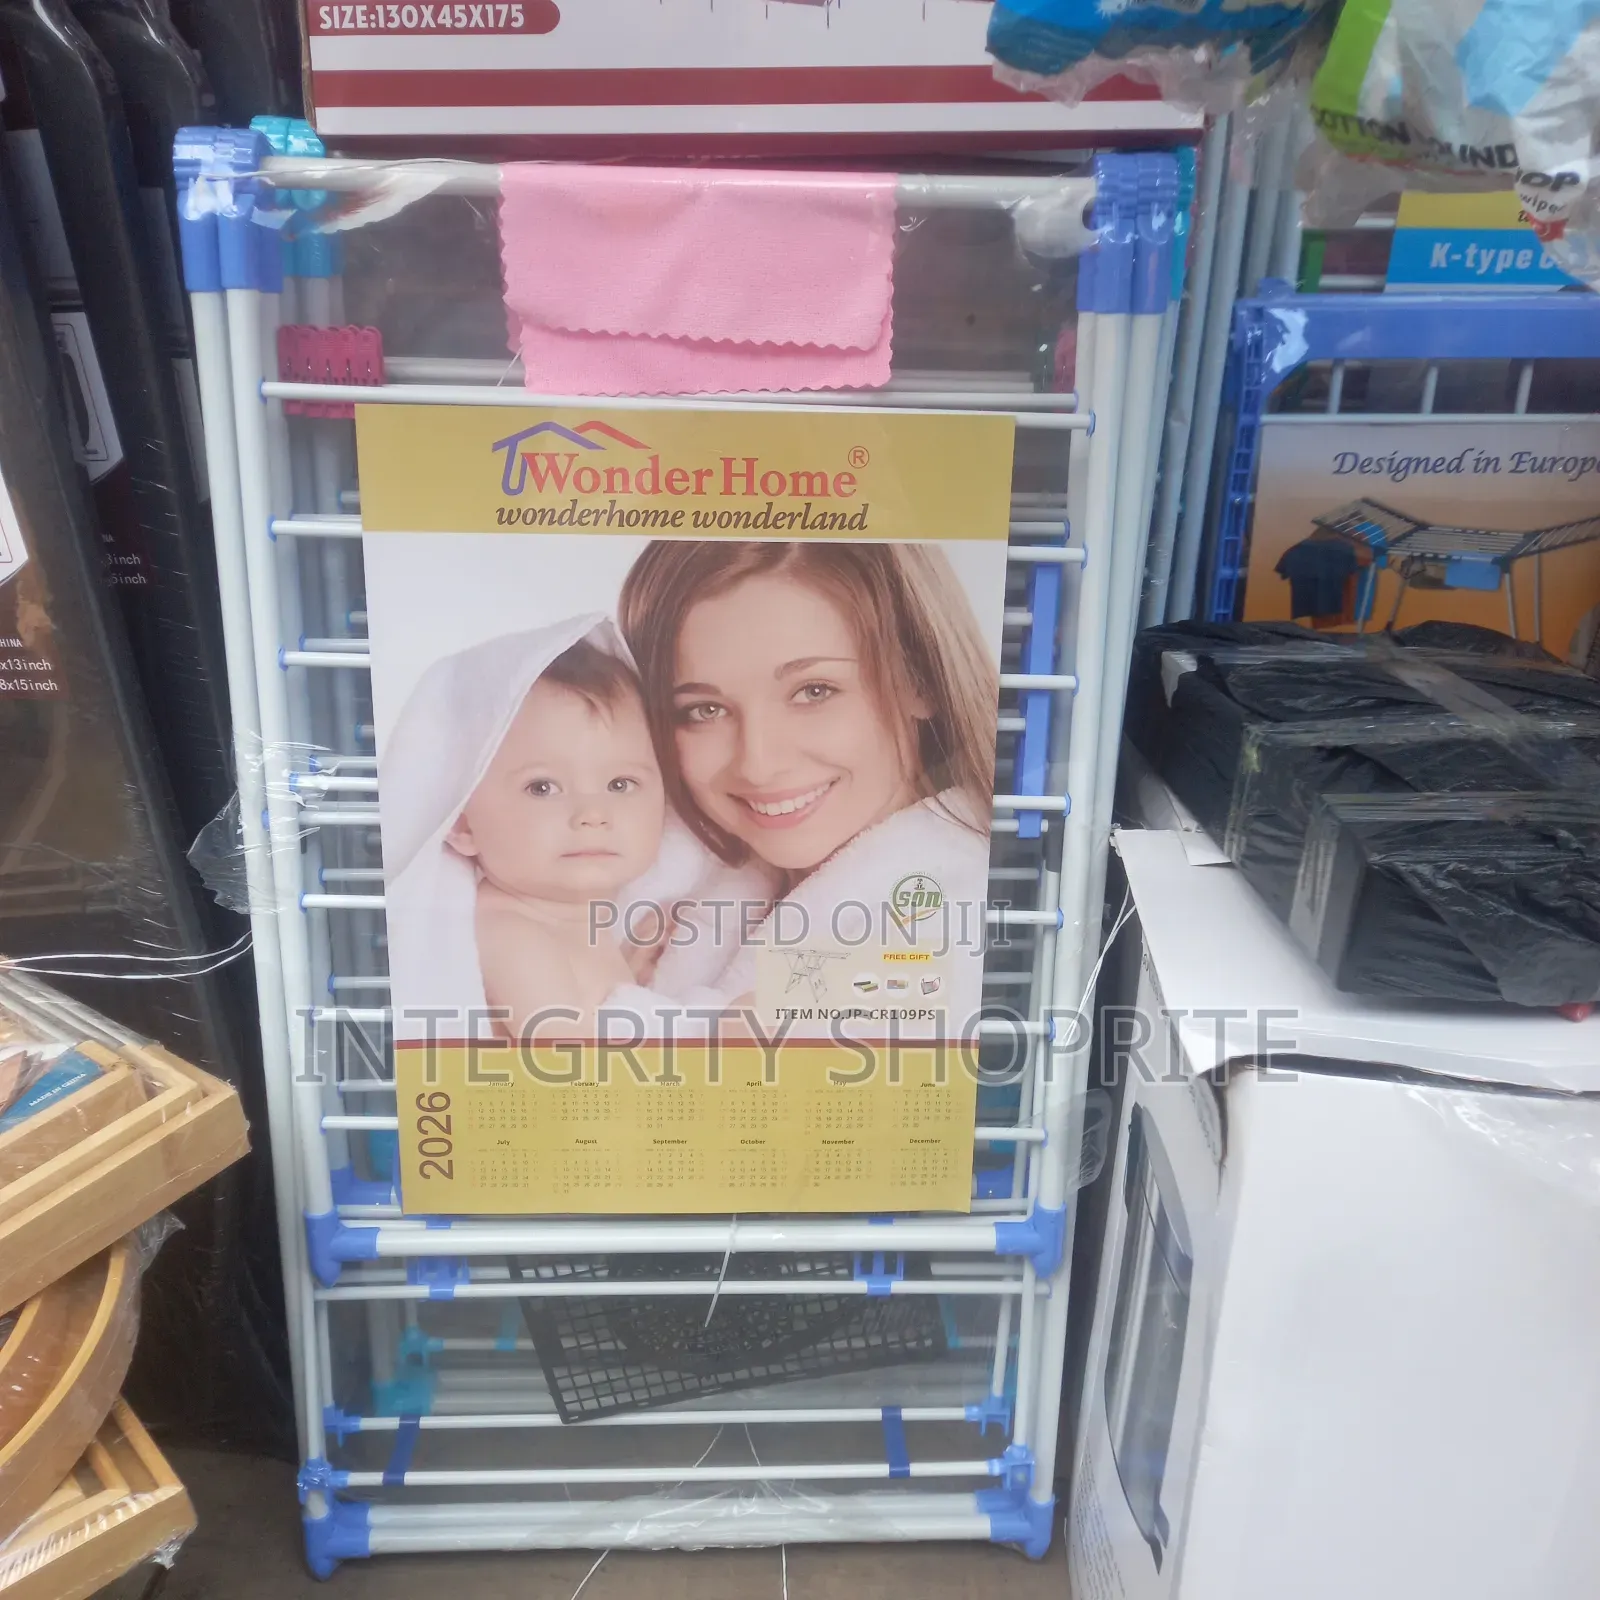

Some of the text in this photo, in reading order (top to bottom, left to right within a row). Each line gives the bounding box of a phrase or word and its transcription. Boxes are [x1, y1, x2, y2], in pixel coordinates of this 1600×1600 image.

[318, 3, 525, 30] SIZE:130X45X175
[1430, 242, 1534, 275] K-type
[520, 452, 714, 497] Wonder
[1332, 447, 1600, 483] Designed in Europ
[496, 498, 870, 531] wonderhome wonderland
[883, 953, 930, 961] FREE GIFT
[775, 1008, 813, 1020] ITEM
[488, 1080, 515, 1088] January
[746, 1080, 763, 1088] April
[415, 1091, 454, 1180] 2026
[574, 1138, 598, 1146] August
[652, 1138, 689, 1146] September
